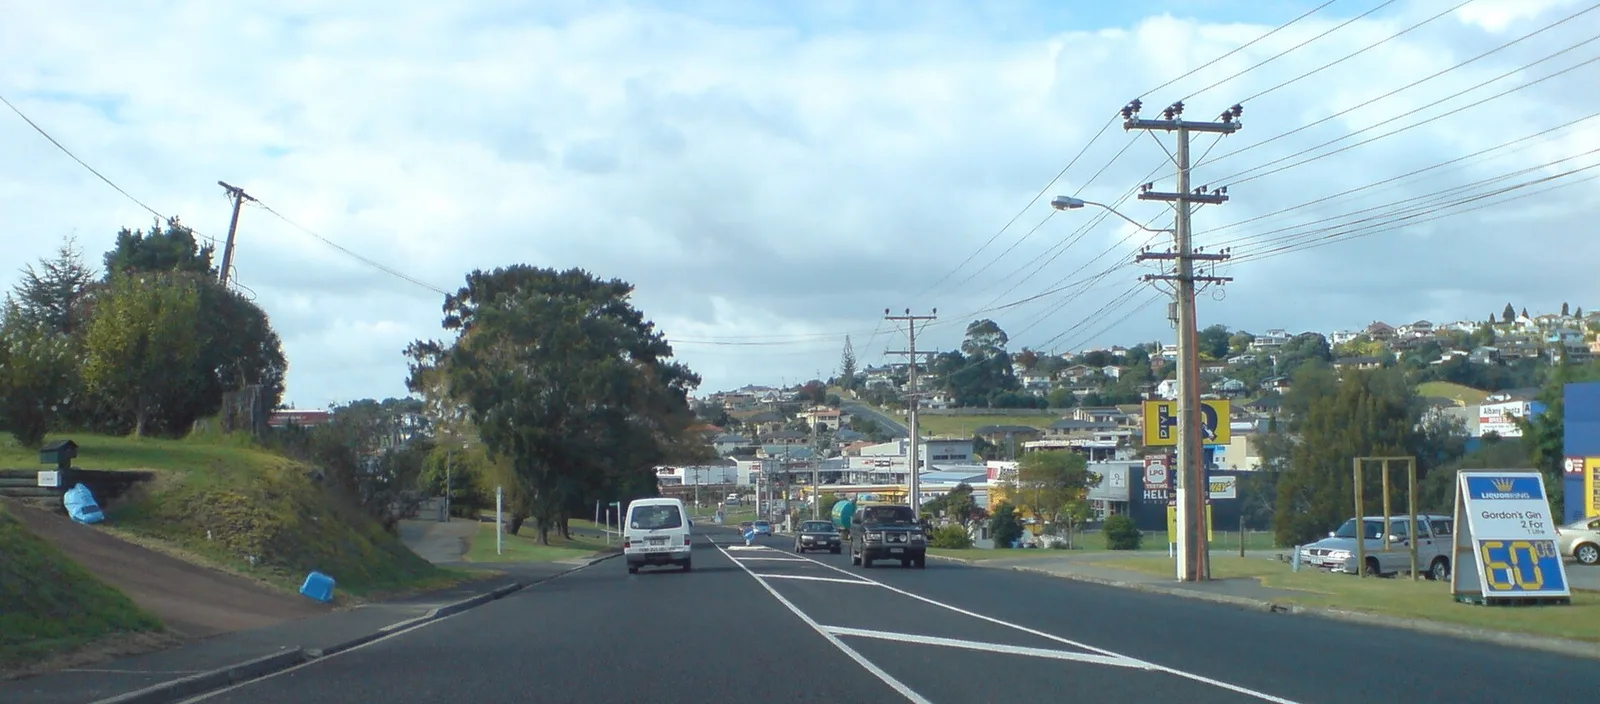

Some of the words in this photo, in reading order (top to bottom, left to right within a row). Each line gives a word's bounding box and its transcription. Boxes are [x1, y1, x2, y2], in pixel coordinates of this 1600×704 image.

[1143, 490, 1168, 499] HELL
[1481, 510, 1522, 519] Gordon's
[1525, 510, 1542, 519] Gin
[1520, 520, 1528, 528] 2
[1529, 520, 1543, 528] For
[1482, 541, 1543, 590] 60
[1534, 541, 1555, 557] 00
